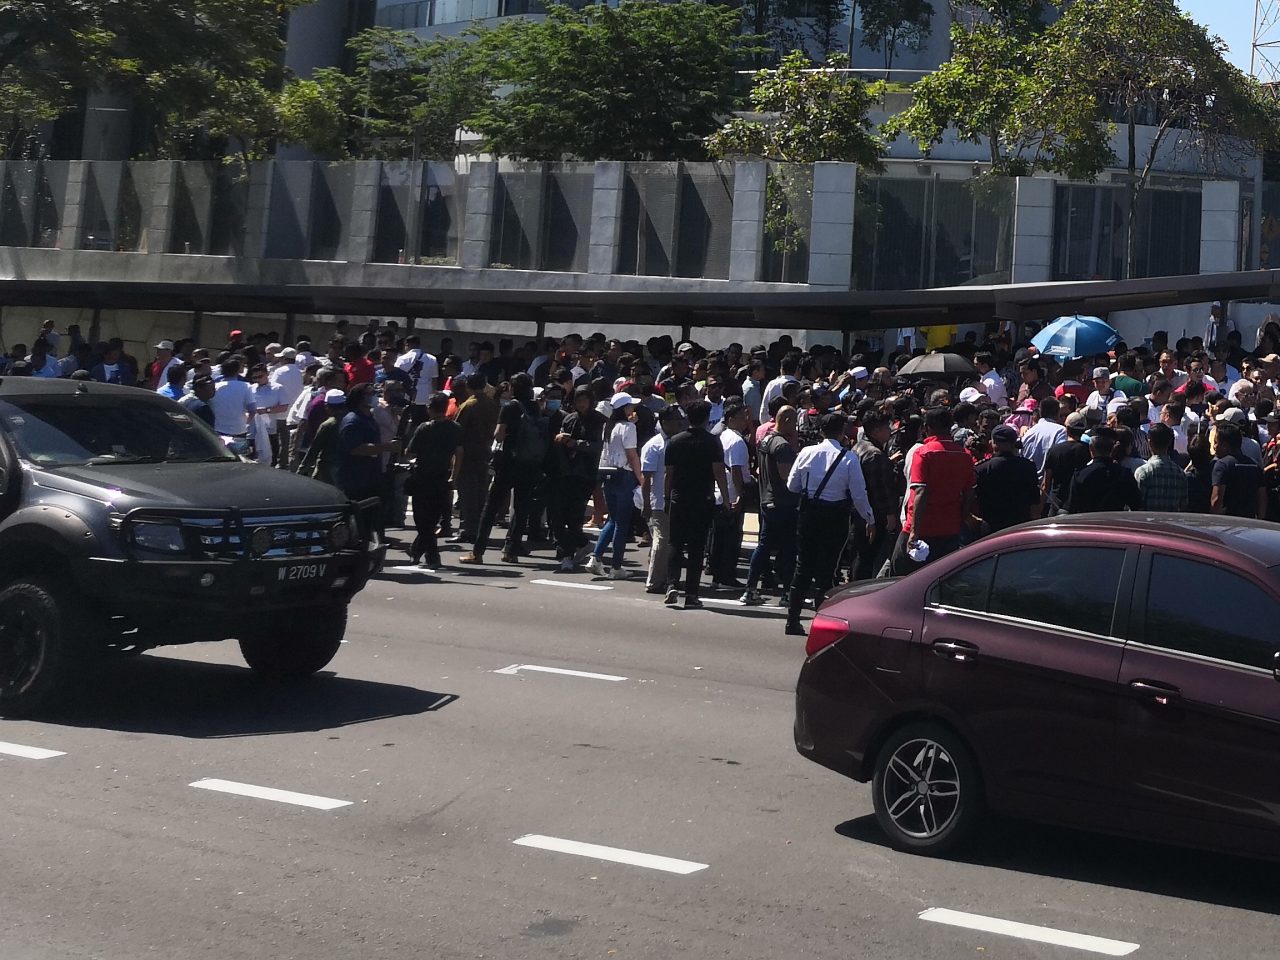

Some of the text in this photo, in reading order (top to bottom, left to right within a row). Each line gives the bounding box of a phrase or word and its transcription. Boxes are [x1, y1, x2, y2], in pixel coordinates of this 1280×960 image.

[278, 563, 327, 580] W 2709 V
